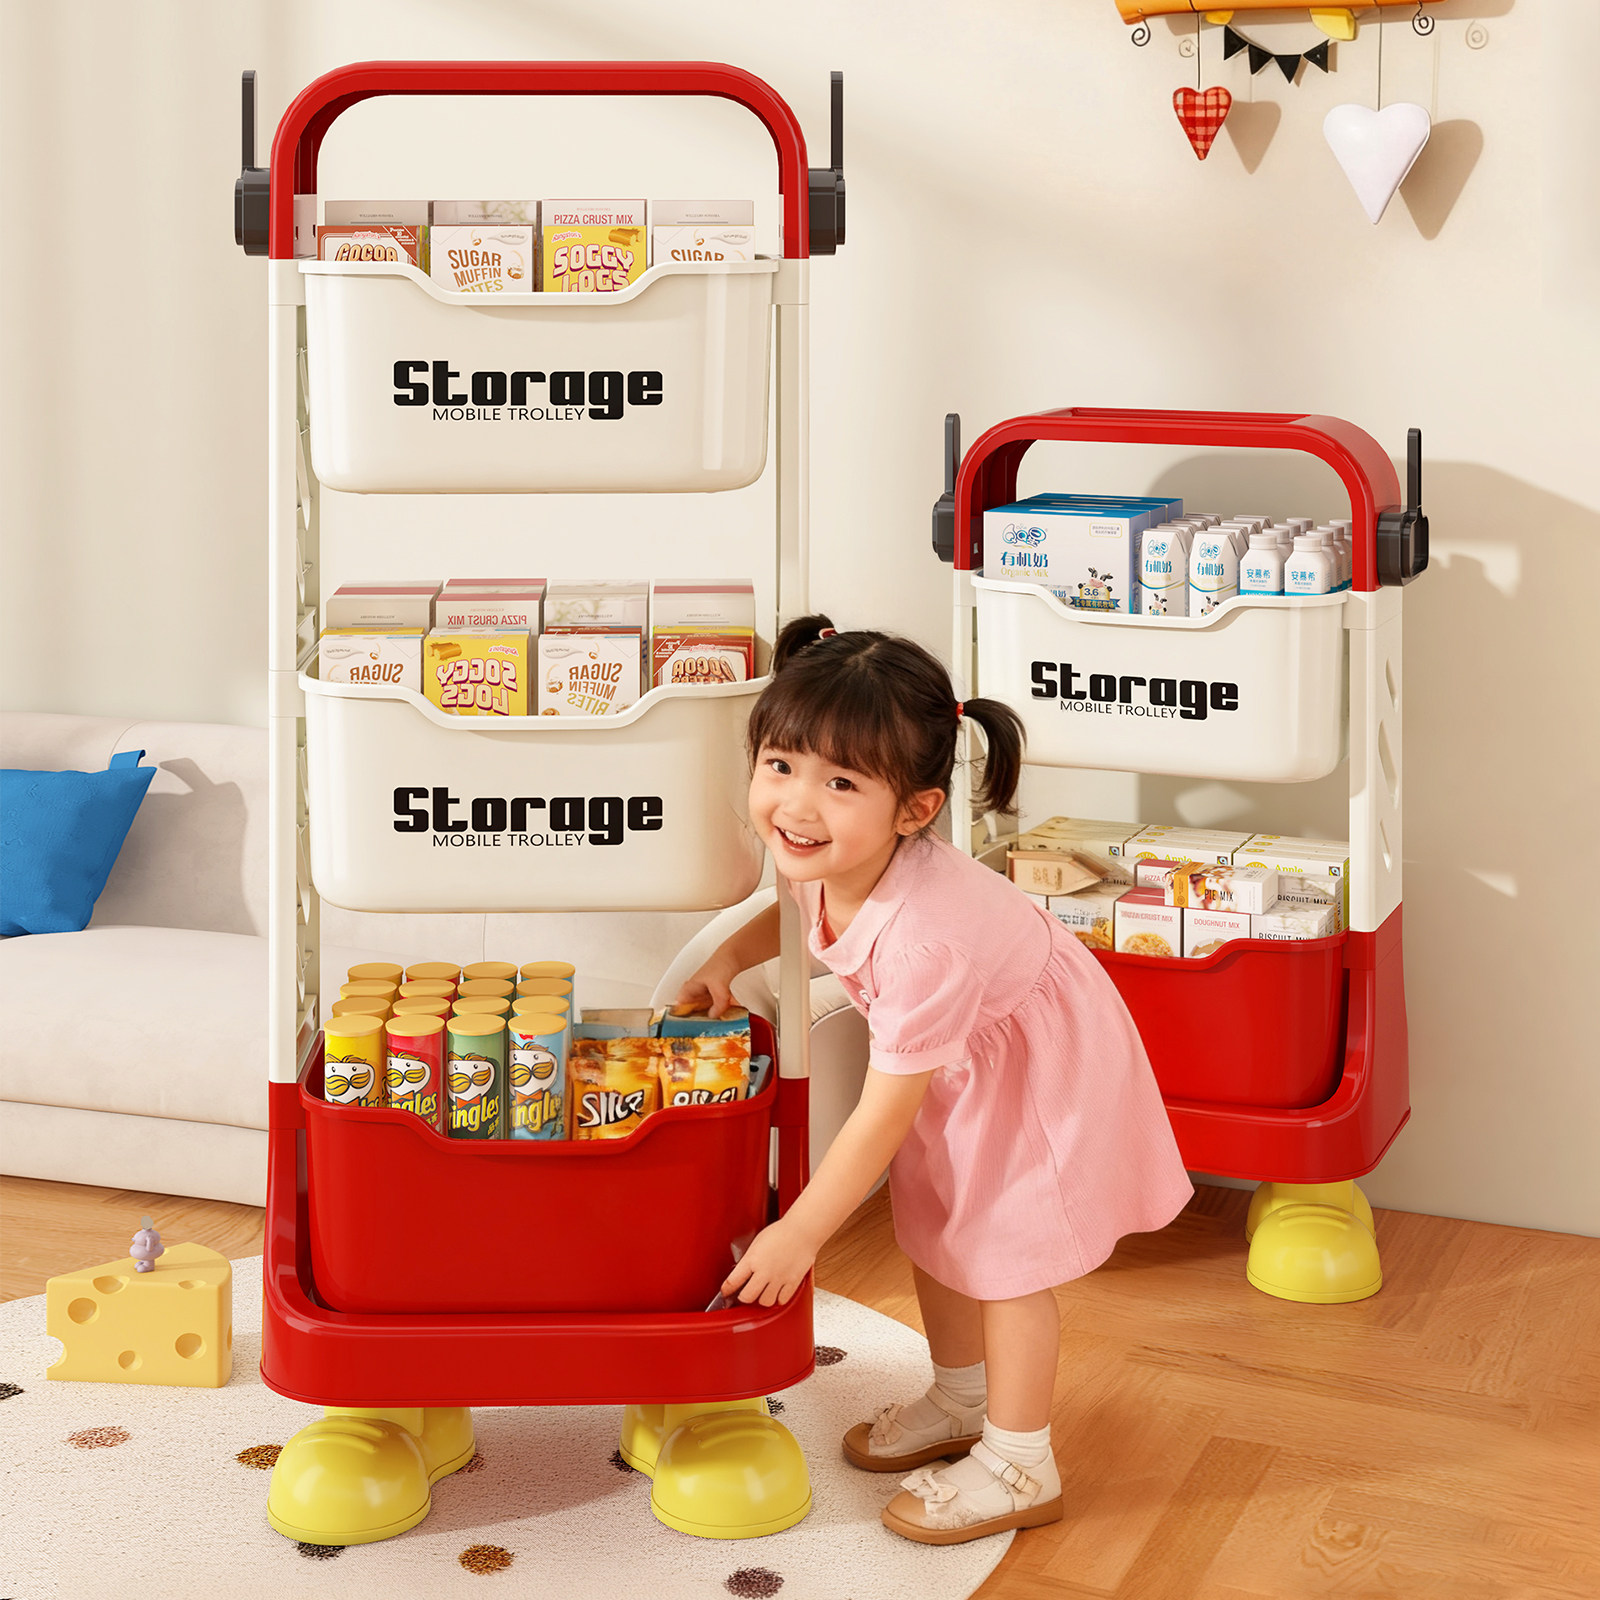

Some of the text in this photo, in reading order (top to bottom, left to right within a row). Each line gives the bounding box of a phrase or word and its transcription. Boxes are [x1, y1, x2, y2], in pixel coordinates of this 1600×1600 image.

[554, 214, 633, 225] PIZZA CRUST MIX
[447, 249, 502, 270] SUGAR
[552, 243, 635, 279] SOGGY
[453, 266, 502, 288] MUFFIN
[561, 268, 631, 292] LOGS
[393, 360, 664, 420] Storage
[433, 407, 585, 421] MOBILE TROLLEY
[1000, 551, 1049, 568] 有机奶
[1145, 559, 1173, 574] 有机奶
[1197, 562, 1225, 576] 有机奶
[1246, 568, 1271, 579] 安慕希
[1291, 570, 1316, 582] 安慕希
[1084, 588, 1099, 596] 3.6
[1031, 661, 1239, 720] Storage
[1060, 700, 1177, 718] MOBILE TROLLEY
[393, 786, 664, 846] Storage
[433, 833, 585, 847] MOBILE TROLLEY
[1144, 874, 1160, 882] PIZZA
[1205, 889, 1234, 902] PIE MIX
[1194, 918, 1240, 929] DOUGHNUT MIX
